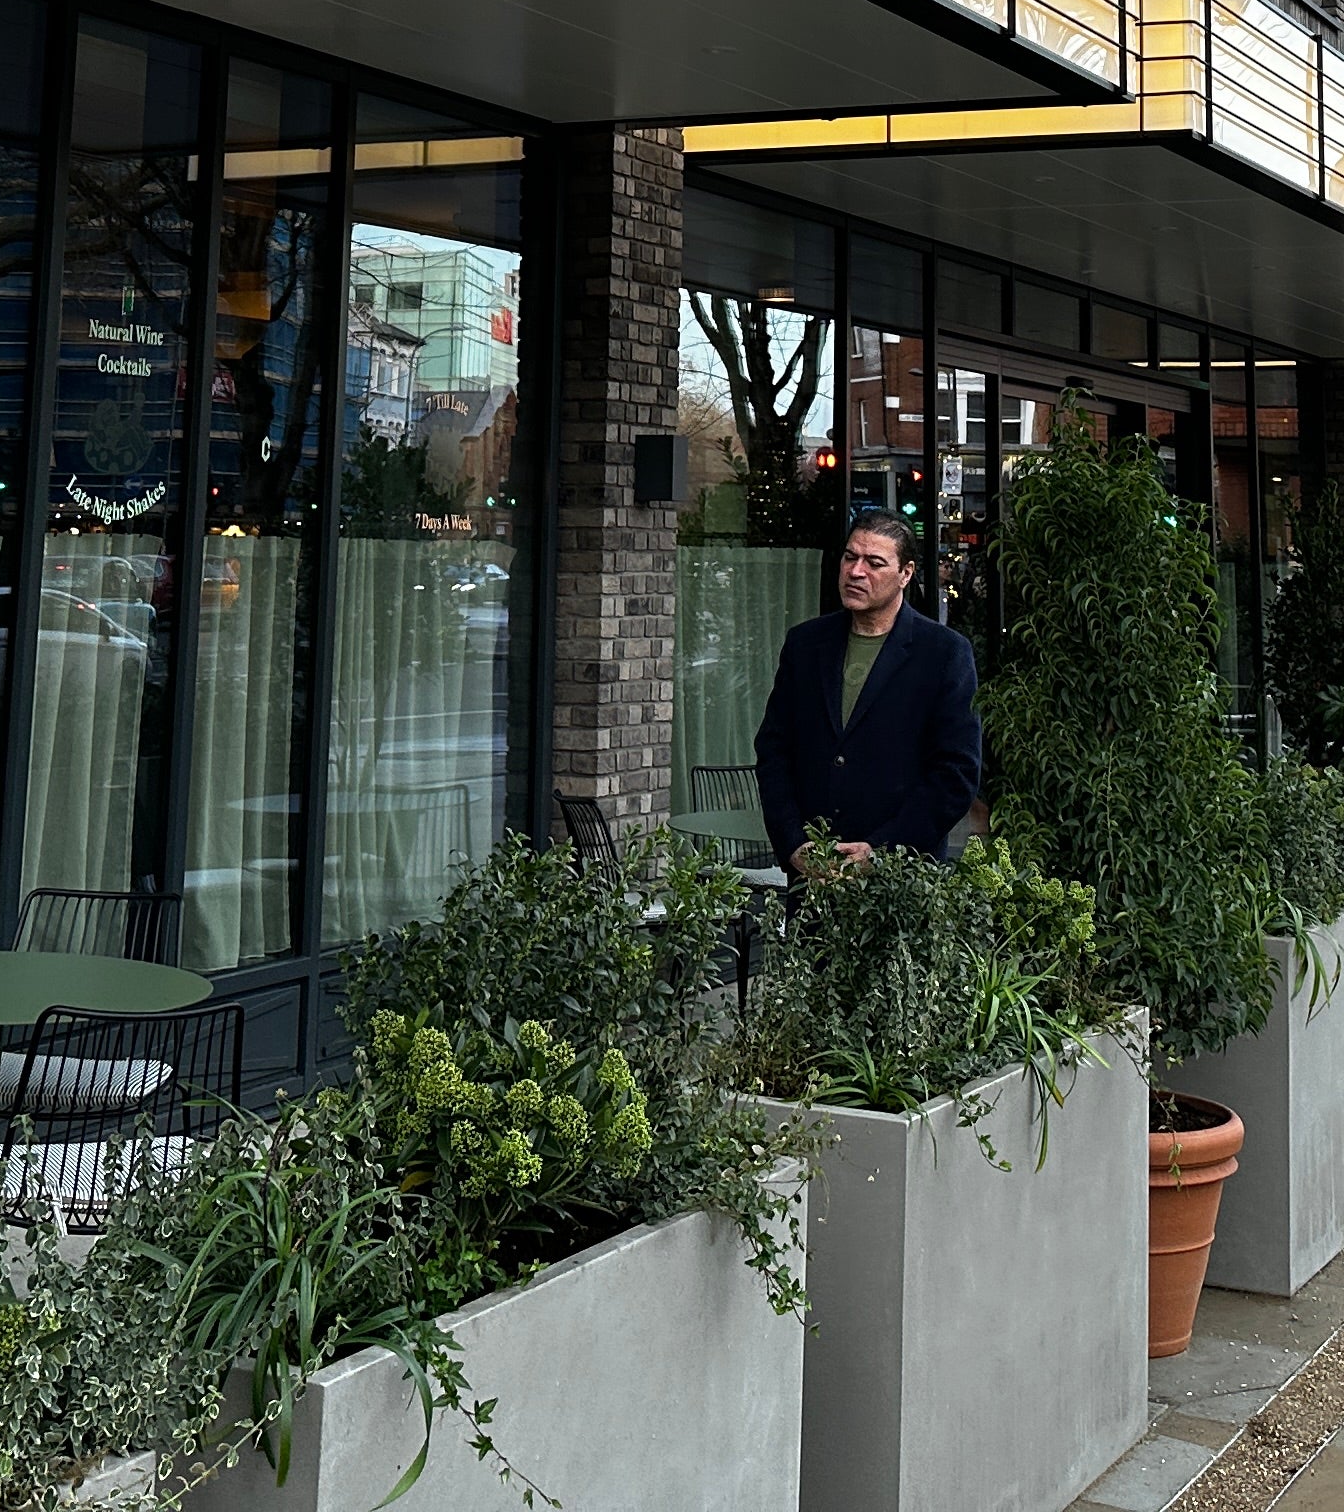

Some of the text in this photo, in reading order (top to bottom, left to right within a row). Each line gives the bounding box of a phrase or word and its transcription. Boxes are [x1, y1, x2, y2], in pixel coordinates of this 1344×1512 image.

[89, 319, 163, 346] Natural Wine
[97, 354, 152, 377] Cocktails
[451, 394, 469, 417] Late
[66, 473, 166, 525] Late Night Shakes
[415, 513, 472, 533] 7 Days A Week
